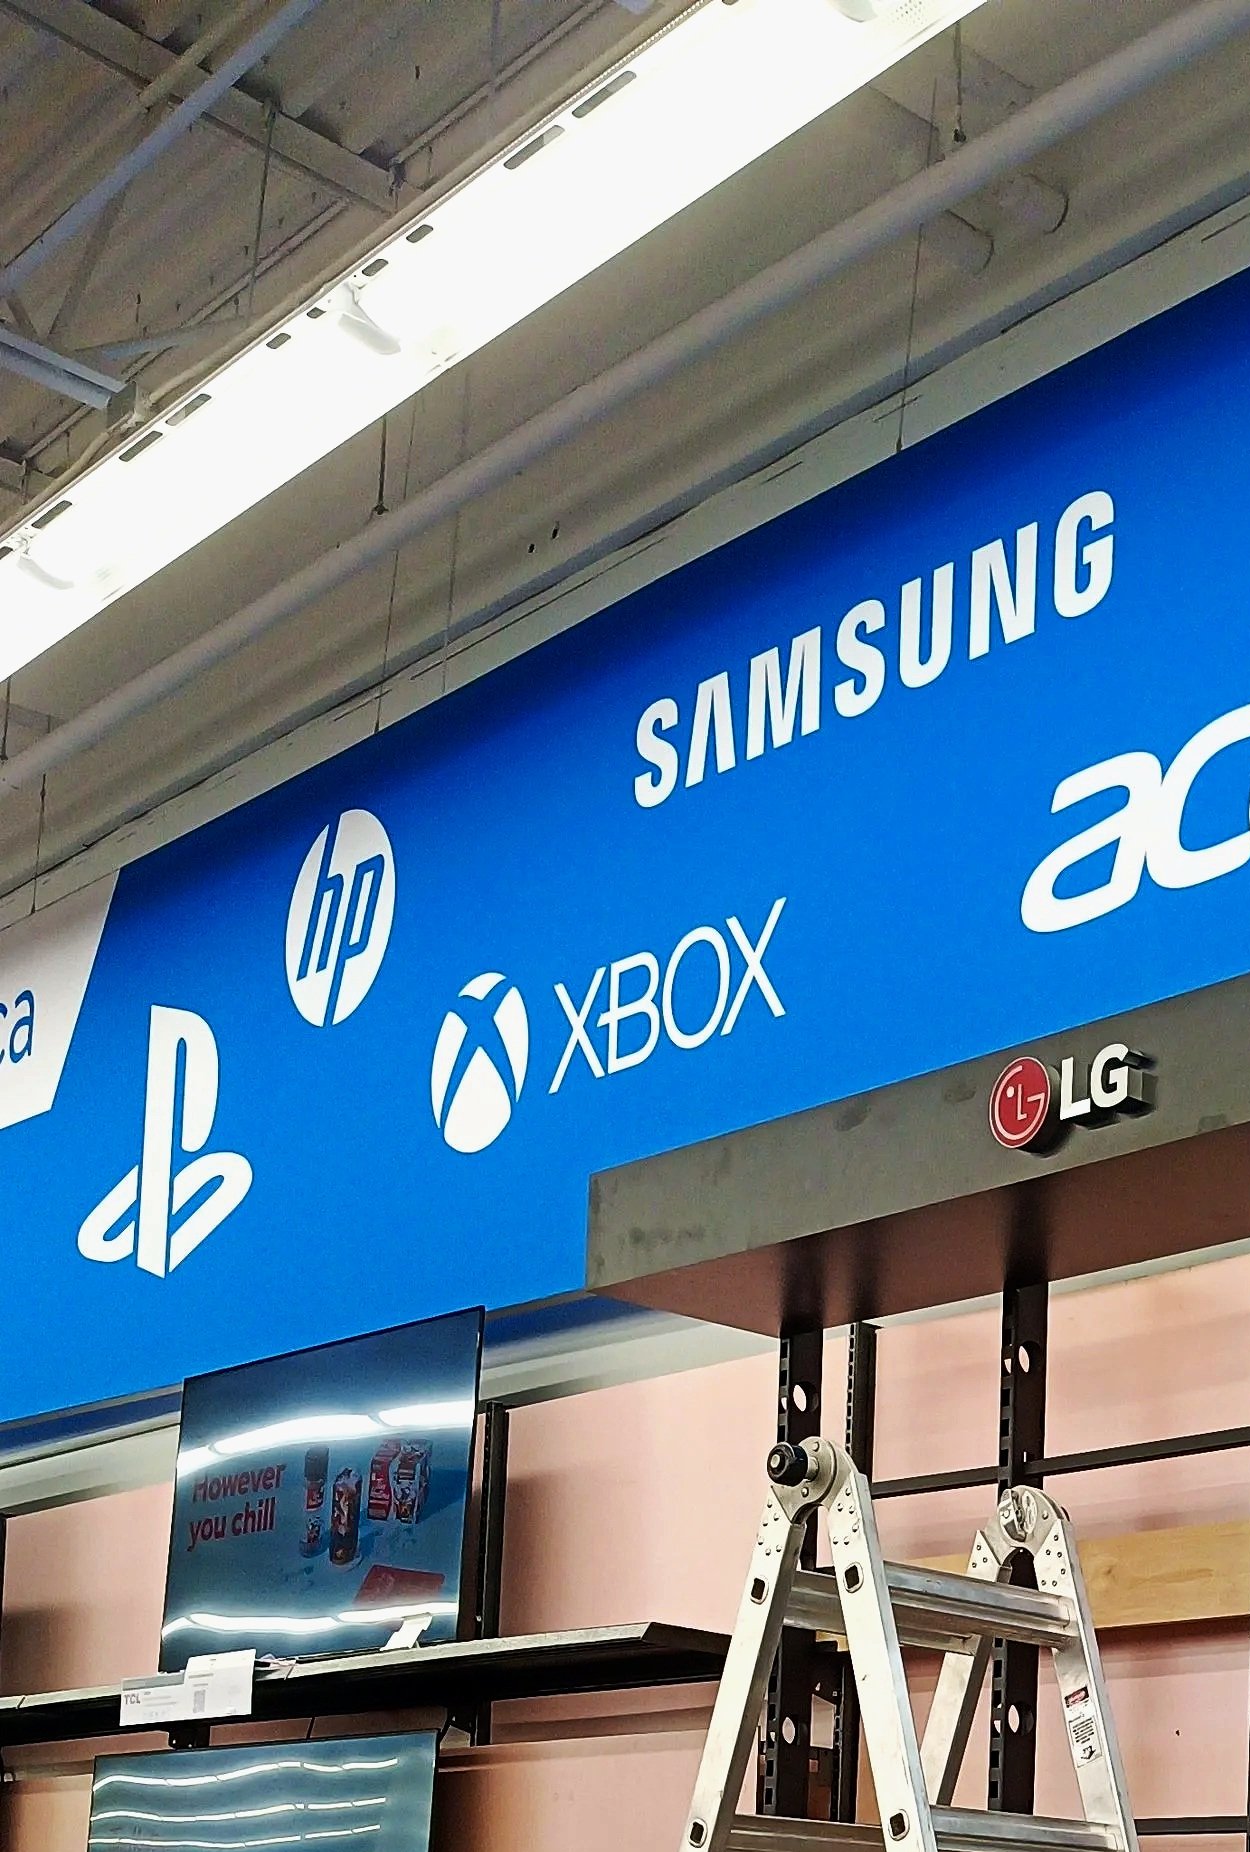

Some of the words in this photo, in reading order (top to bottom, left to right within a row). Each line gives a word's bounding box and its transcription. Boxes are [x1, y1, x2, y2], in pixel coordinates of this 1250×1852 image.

[634, 491, 1115, 808] SAMSUNG
[285, 808, 396, 1028] hp
[548, 897, 786, 1095] XBOX
[1060, 1043, 1130, 1121] LG
[187, 1515, 226, 1552] you
[231, 1496, 277, 1537] chill
[192, 1463, 287, 1503] However
